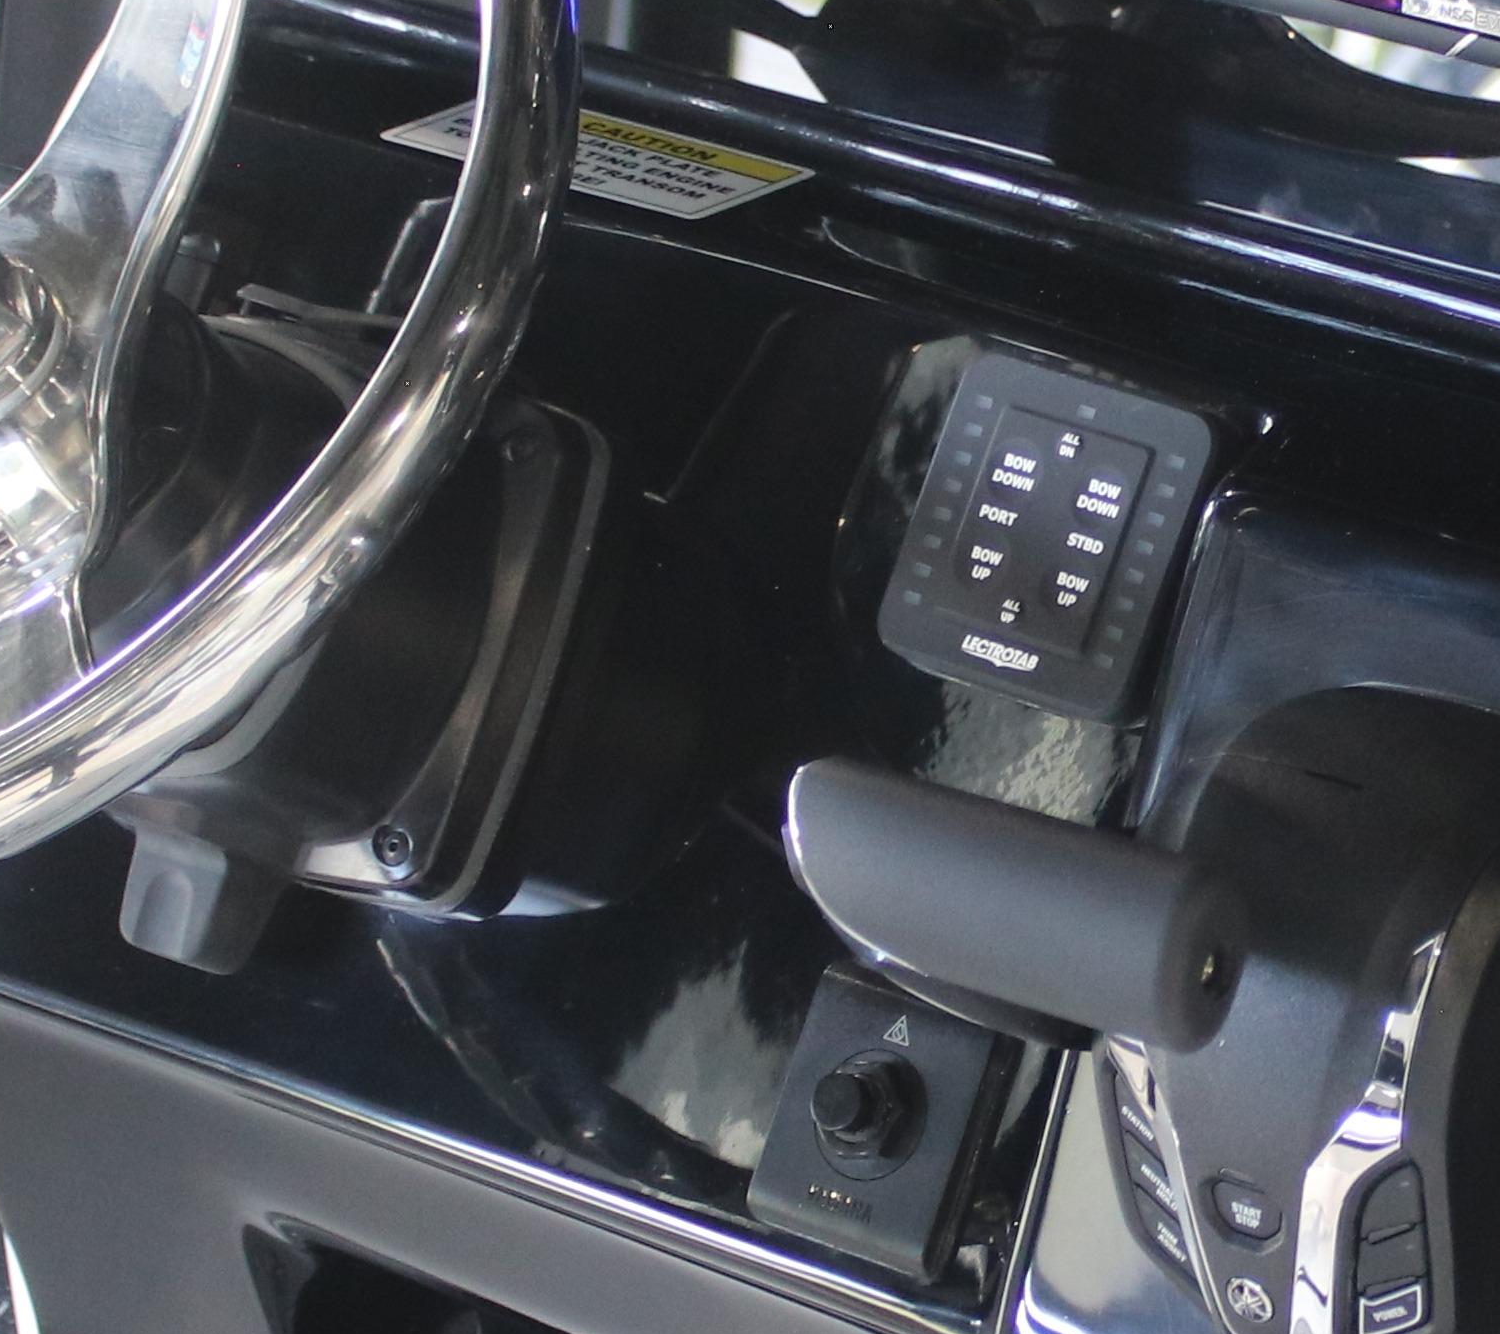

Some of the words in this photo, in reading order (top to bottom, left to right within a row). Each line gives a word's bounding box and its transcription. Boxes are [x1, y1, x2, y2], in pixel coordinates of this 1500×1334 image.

[582, 122, 718, 161] CAUTION
[579, 138, 643, 157] JACK
[646, 154, 723, 177] PLATE
[593, 166, 707, 200] TRANSOM
[643, 167, 737, 194] ENGINE
[1061, 432, 1081, 446] ALL
[1059, 445, 1076, 458] DN
[1003, 453, 1037, 473] BOW
[991, 468, 1035, 492] DOWN
[1088, 478, 1121, 500] BOW
[978, 504, 1018, 527] PORT
[1076, 494, 1120, 519] DOWN
[1066, 532, 1104, 555] STBD
[970, 545, 1004, 566] BOW
[971, 565, 992, 580] UP
[1056, 571, 1090, 593] BOW
[1002, 599, 1021, 613] ALL
[1057, 591, 1077, 607] UP
[1000, 612, 1015, 624] UP
[961, 634, 1040, 671] LECTROTAB
